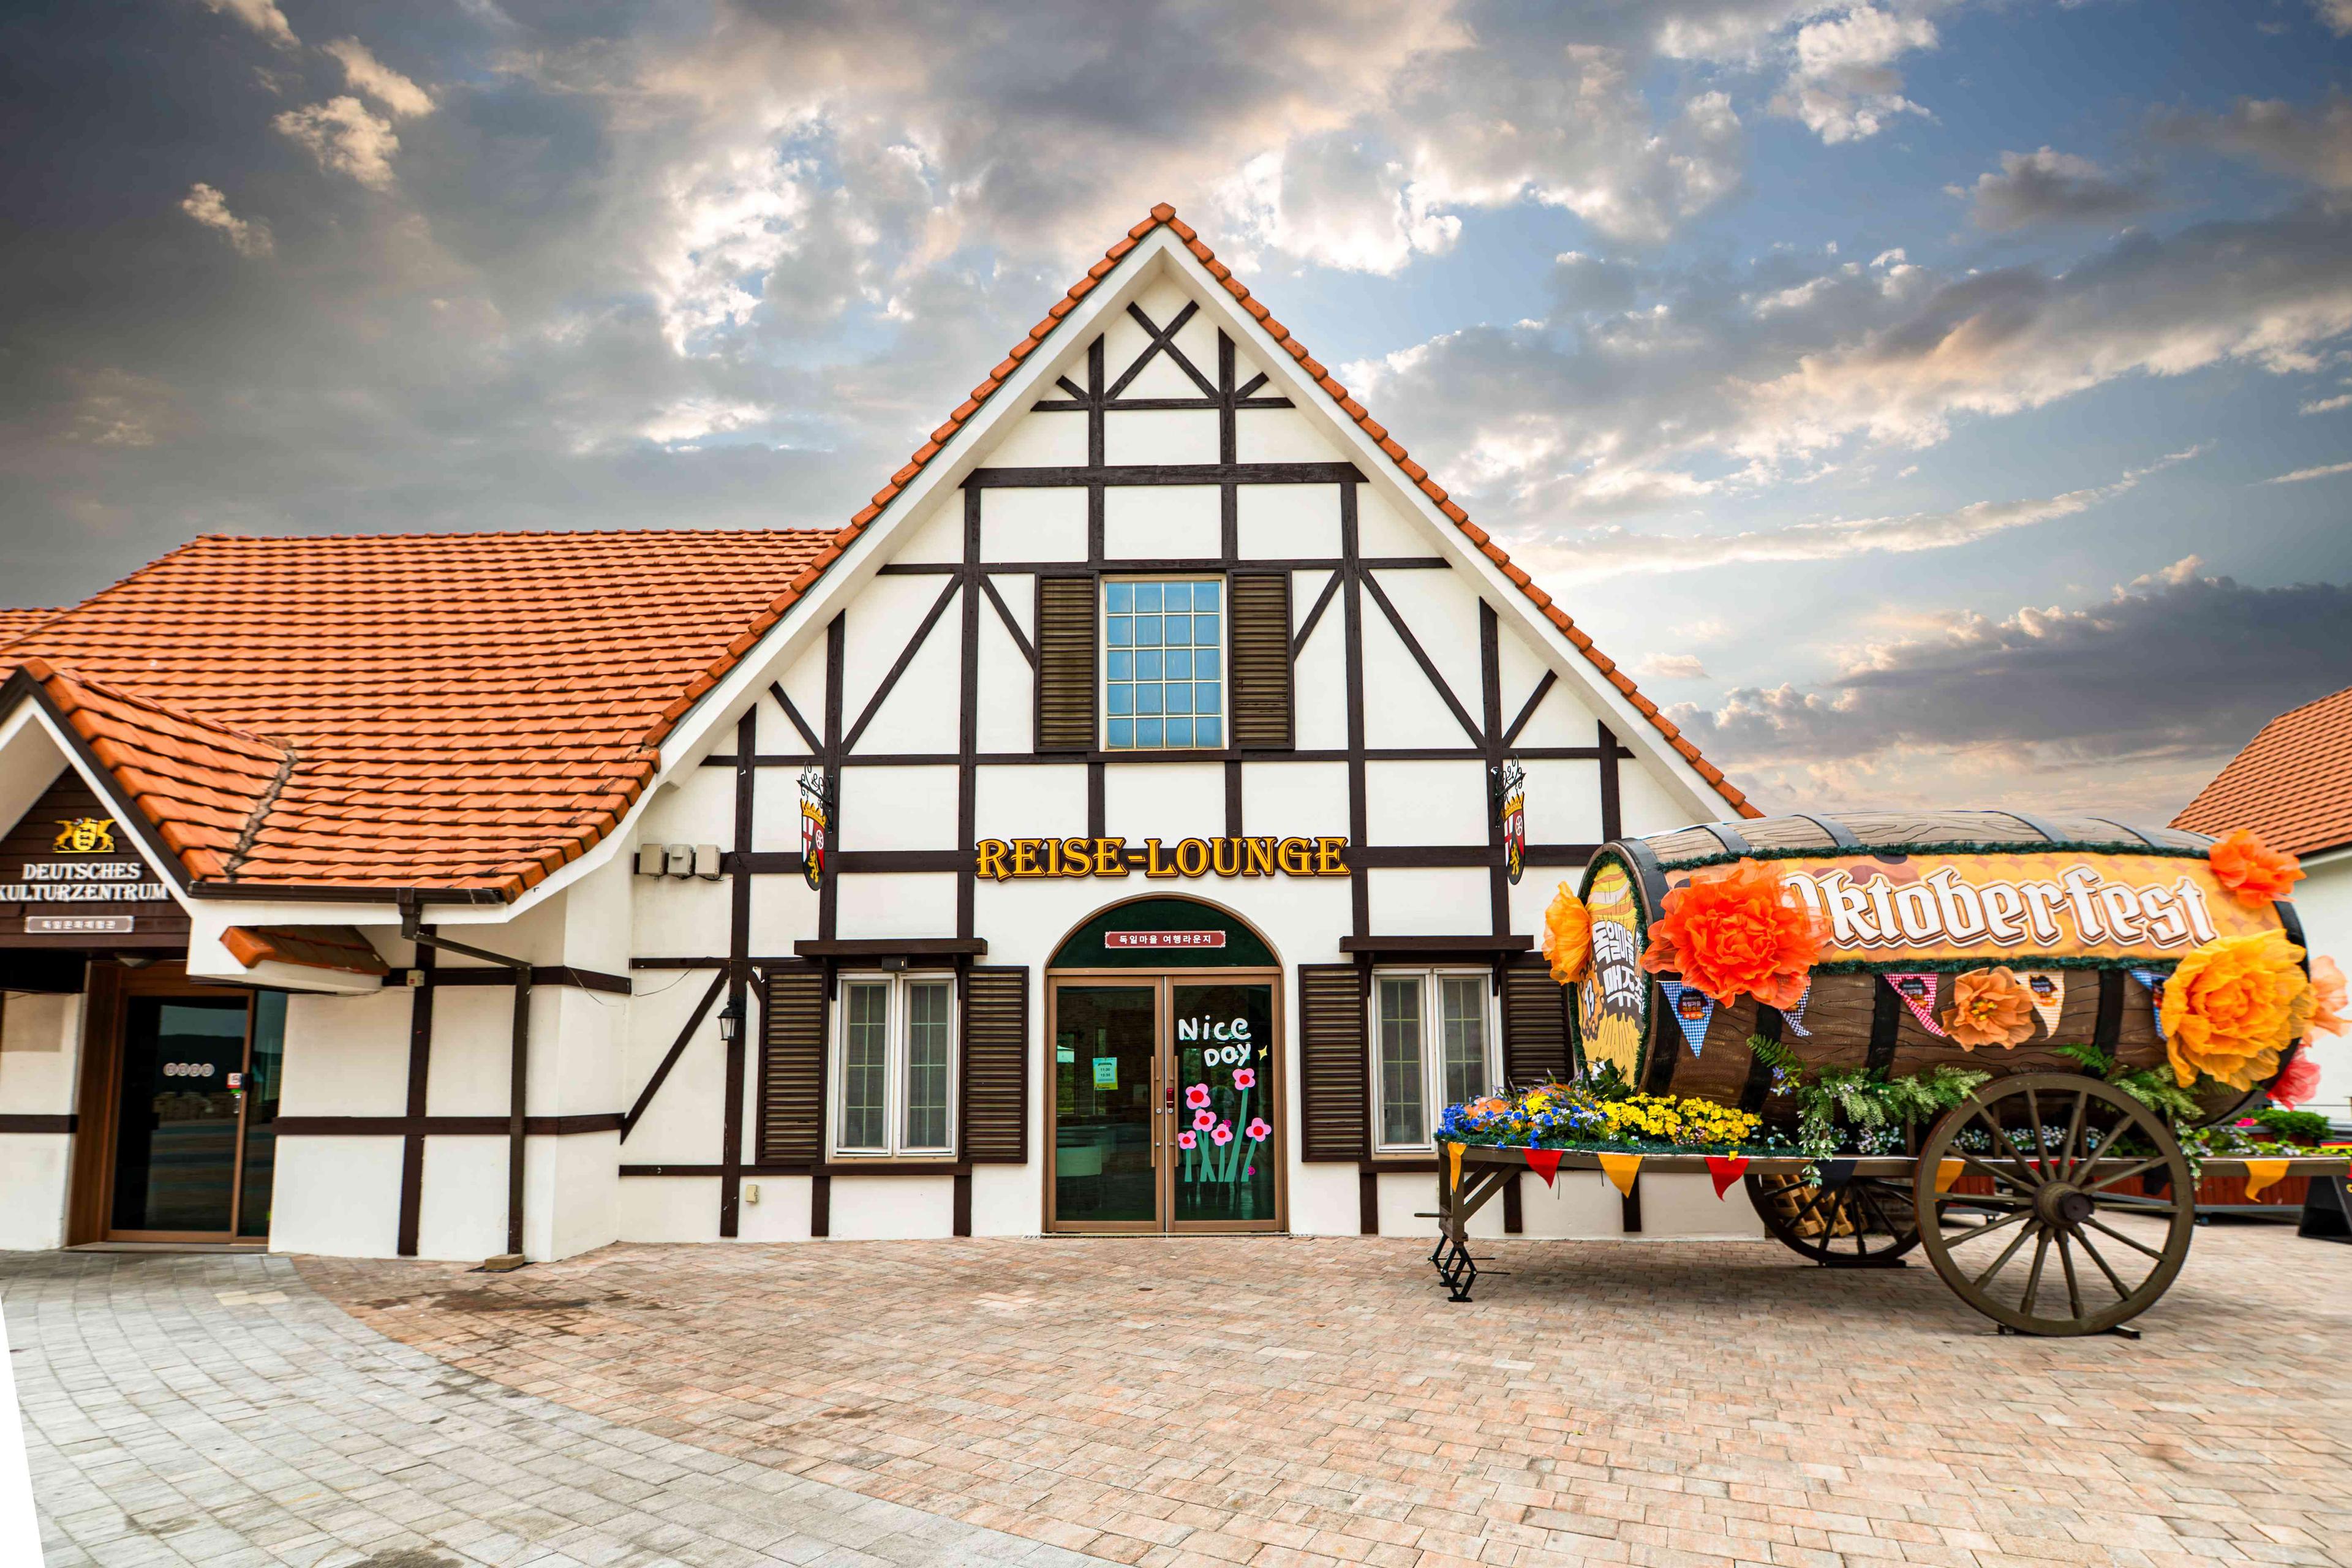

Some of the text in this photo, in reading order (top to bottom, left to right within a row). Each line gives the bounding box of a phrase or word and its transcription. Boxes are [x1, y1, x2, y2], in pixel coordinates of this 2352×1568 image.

[22, 862, 141, 881] DEUTSCHES
[976, 836, 1351, 882] REISE-LOUNGE
[1119, 934, 1212, 944] 독일마을 여행라운지
[1592, 920, 1635, 967] 독일마을
[1602, 964, 1645, 1014] 맥주축
[1178, 1014, 1252, 1041] Nice
